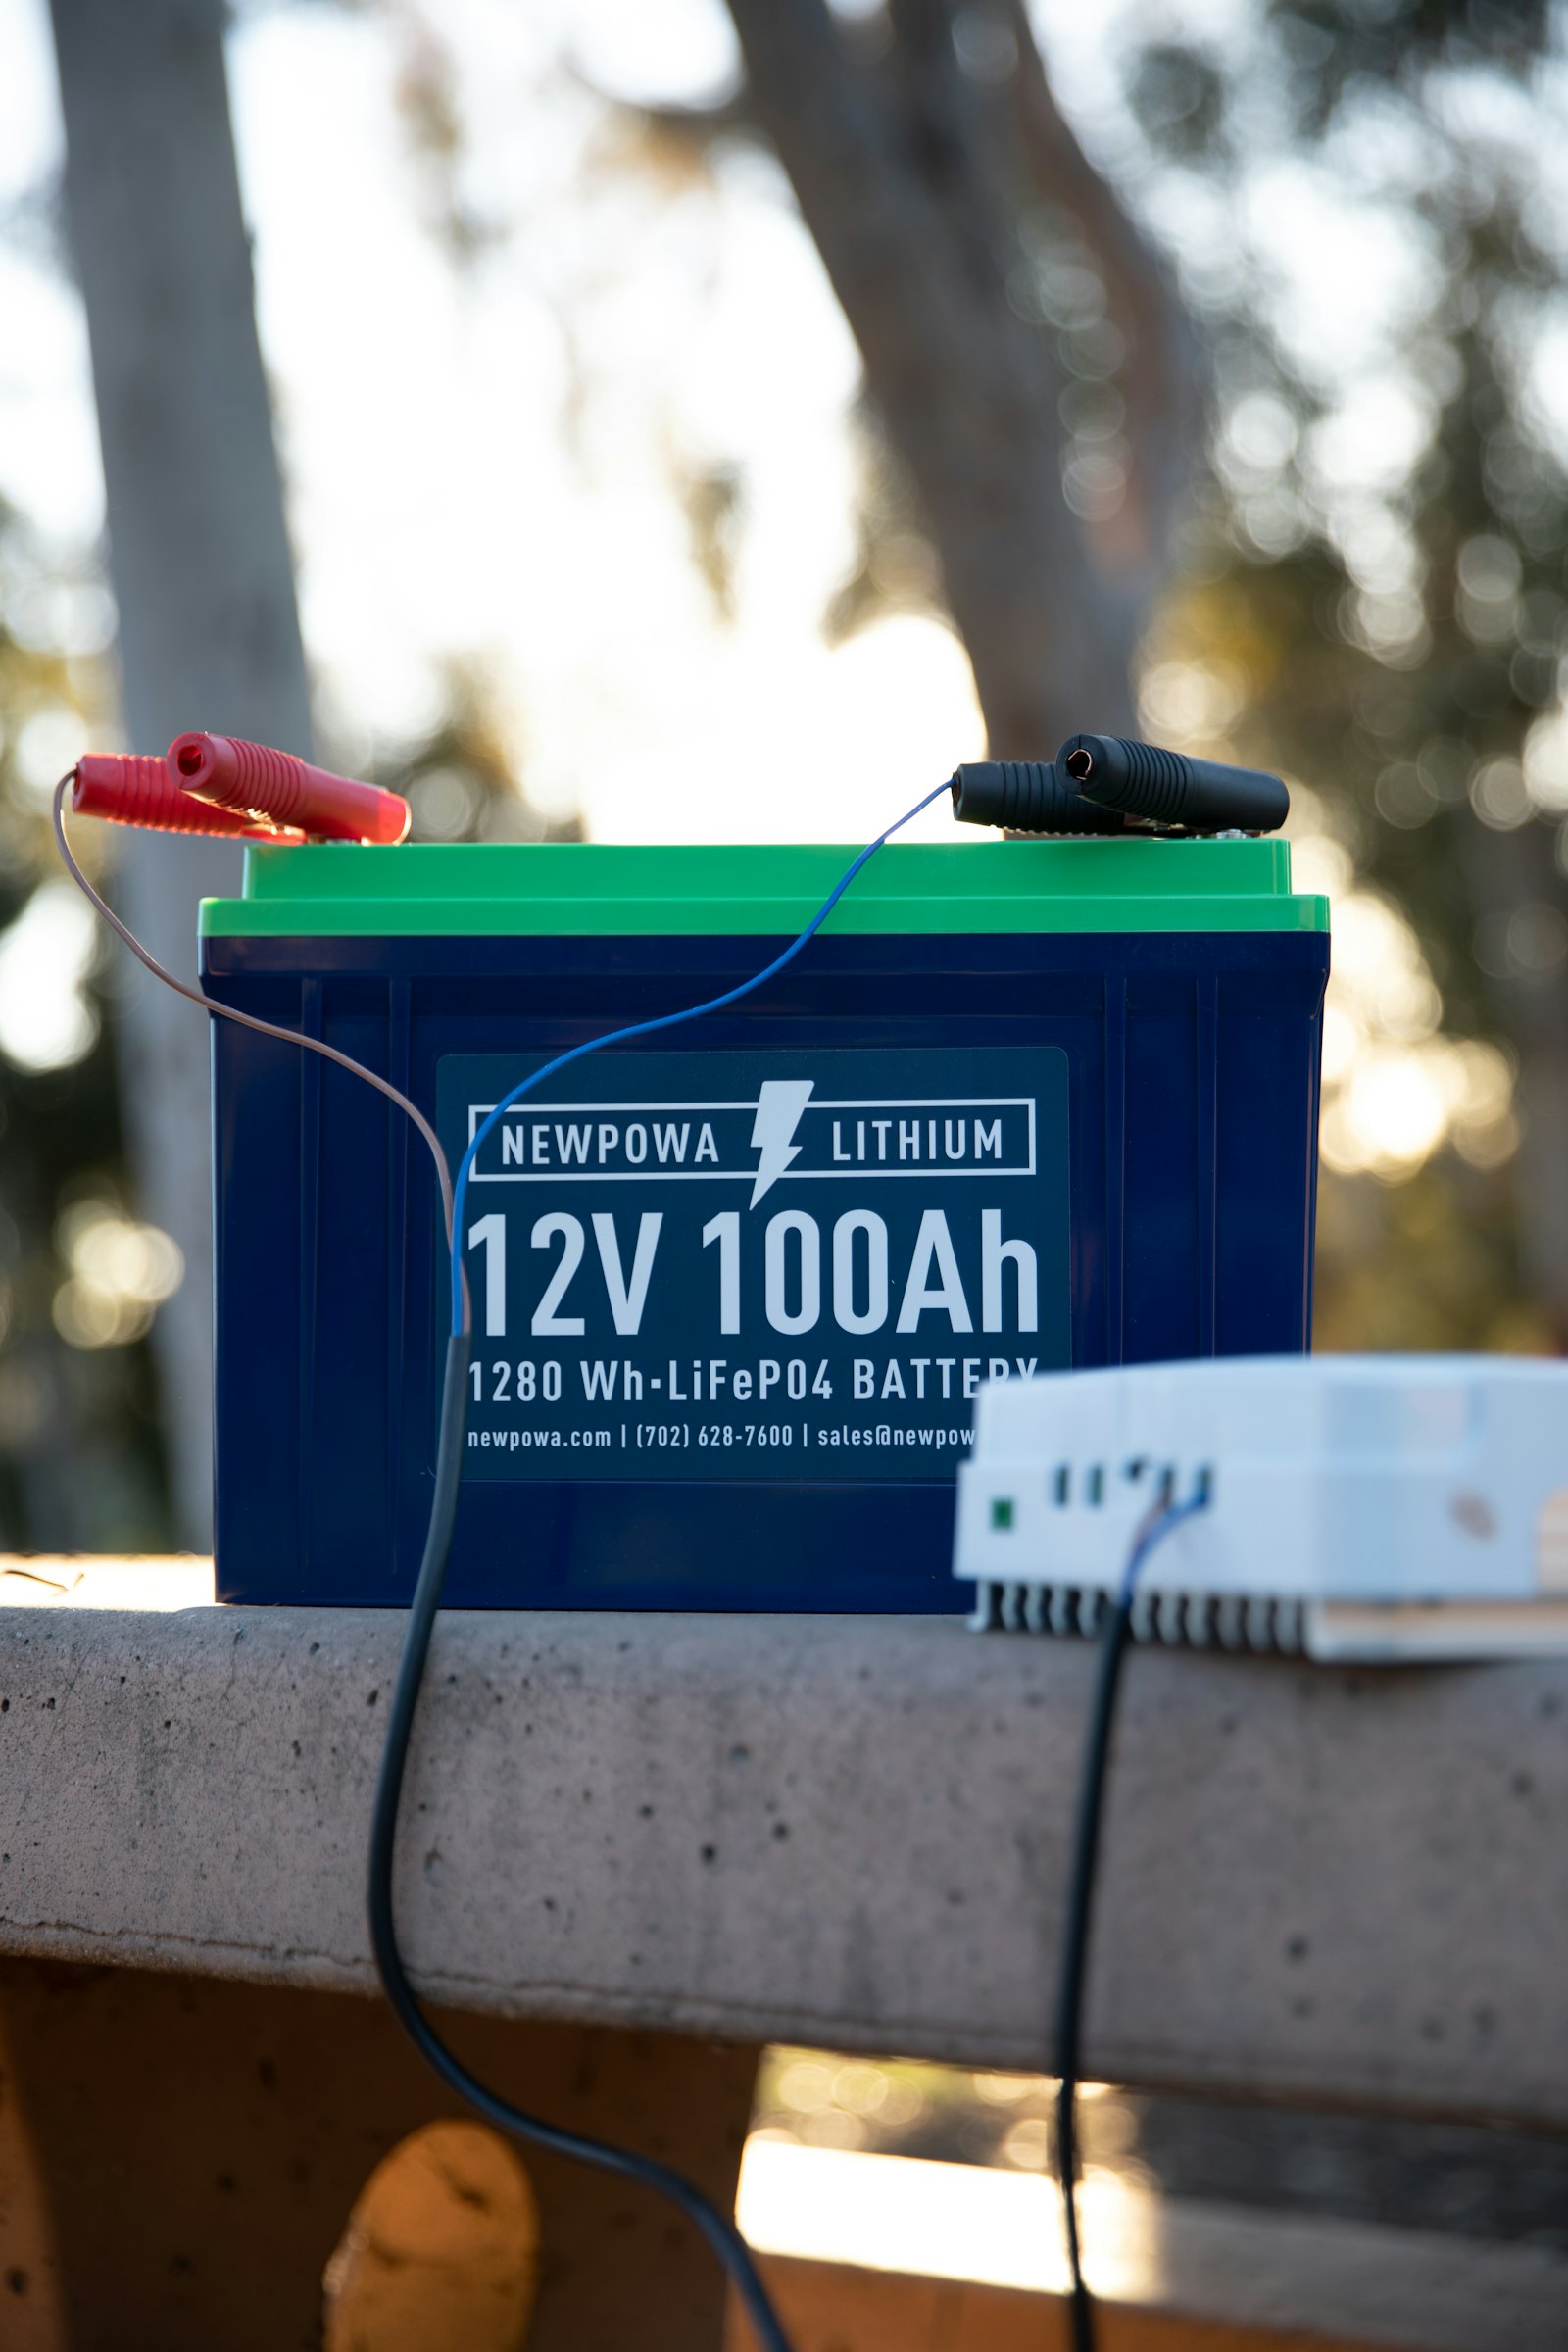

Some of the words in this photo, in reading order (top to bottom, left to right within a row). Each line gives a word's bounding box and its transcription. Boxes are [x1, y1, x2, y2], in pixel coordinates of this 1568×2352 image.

[502, 1122, 719, 1165] NEWPOWA
[832, 1118, 1003, 1161] LITHIUM
[467, 1211, 664, 1337] 12V
[702, 1208, 1039, 1336] 100Ah
[468, 1359, 562, 1402] 1280
[467, 1430, 611, 1452] newpowa.com
[636, 1423, 690, 1448] (702)
[698, 1424, 793, 1446] 628-7600
